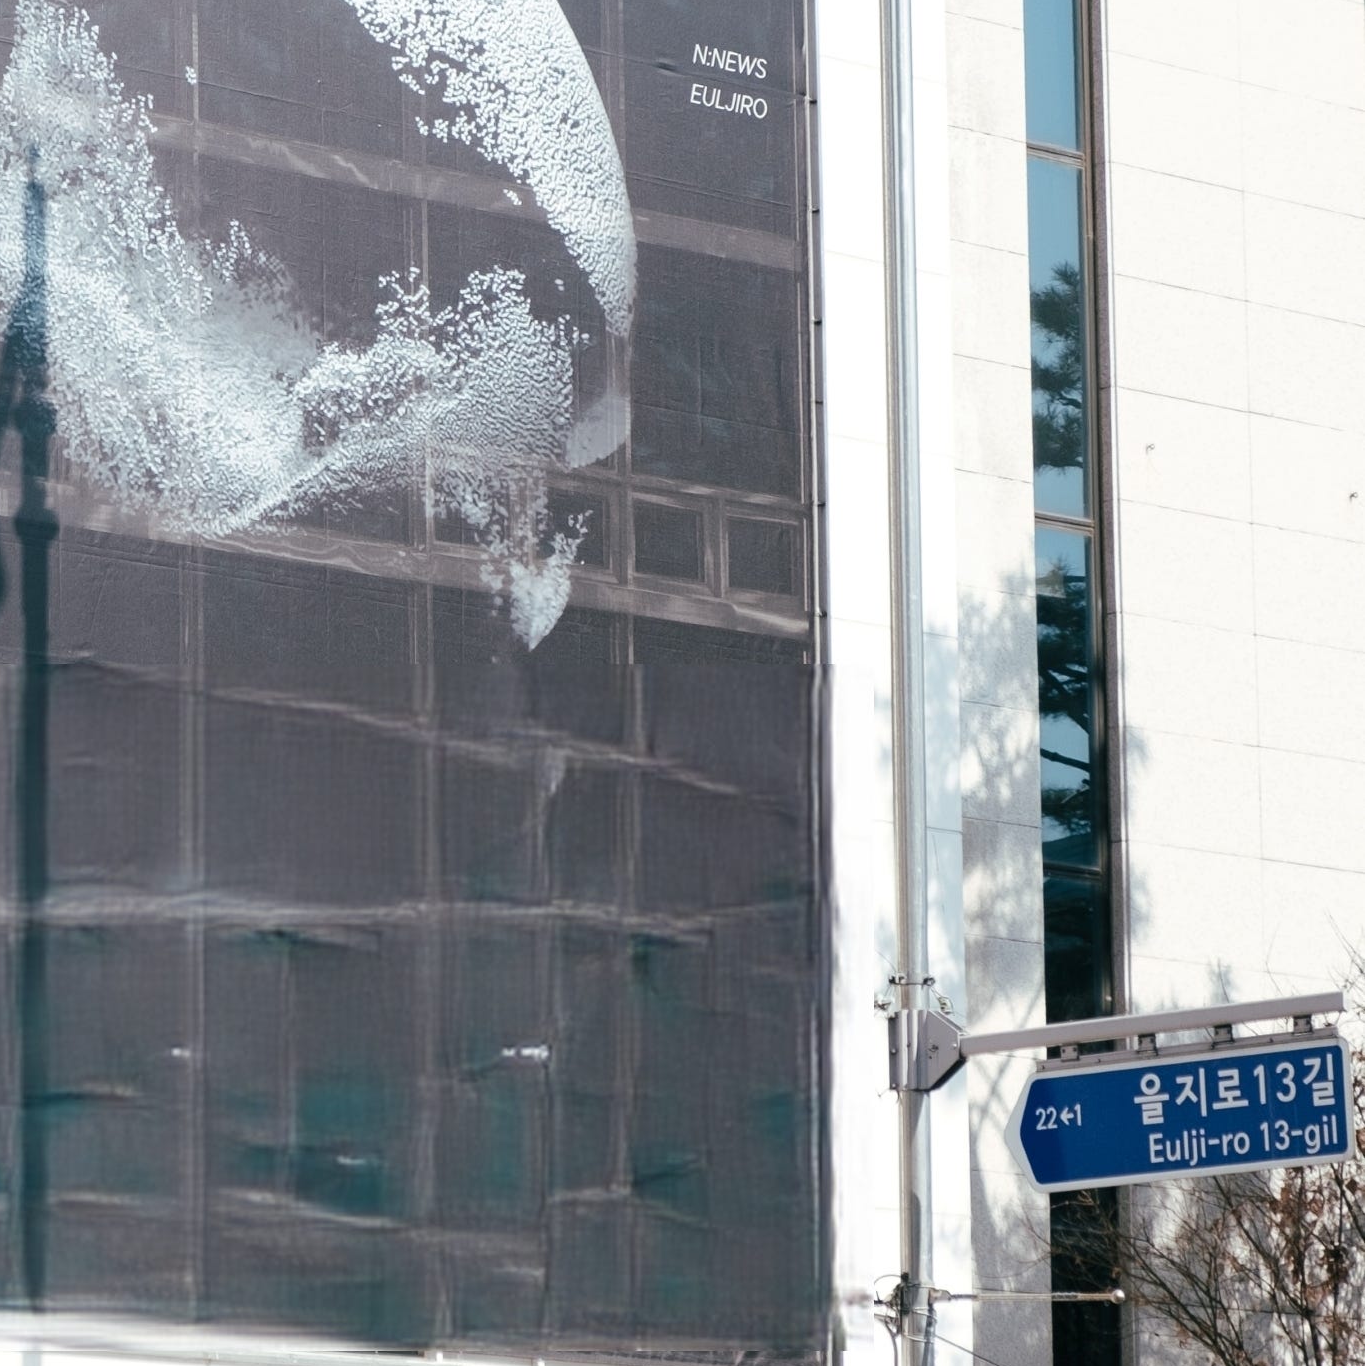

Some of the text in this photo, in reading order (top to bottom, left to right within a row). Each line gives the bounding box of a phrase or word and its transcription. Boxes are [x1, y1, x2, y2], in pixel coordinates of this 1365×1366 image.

[692, 43, 768, 79] N:NEWS
[689, 83, 768, 119] EULJIRO
[1133, 1052, 1336, 1126] 을지로13길
[1148, 1114, 1338, 1167] Eulji-ro 13-gil
